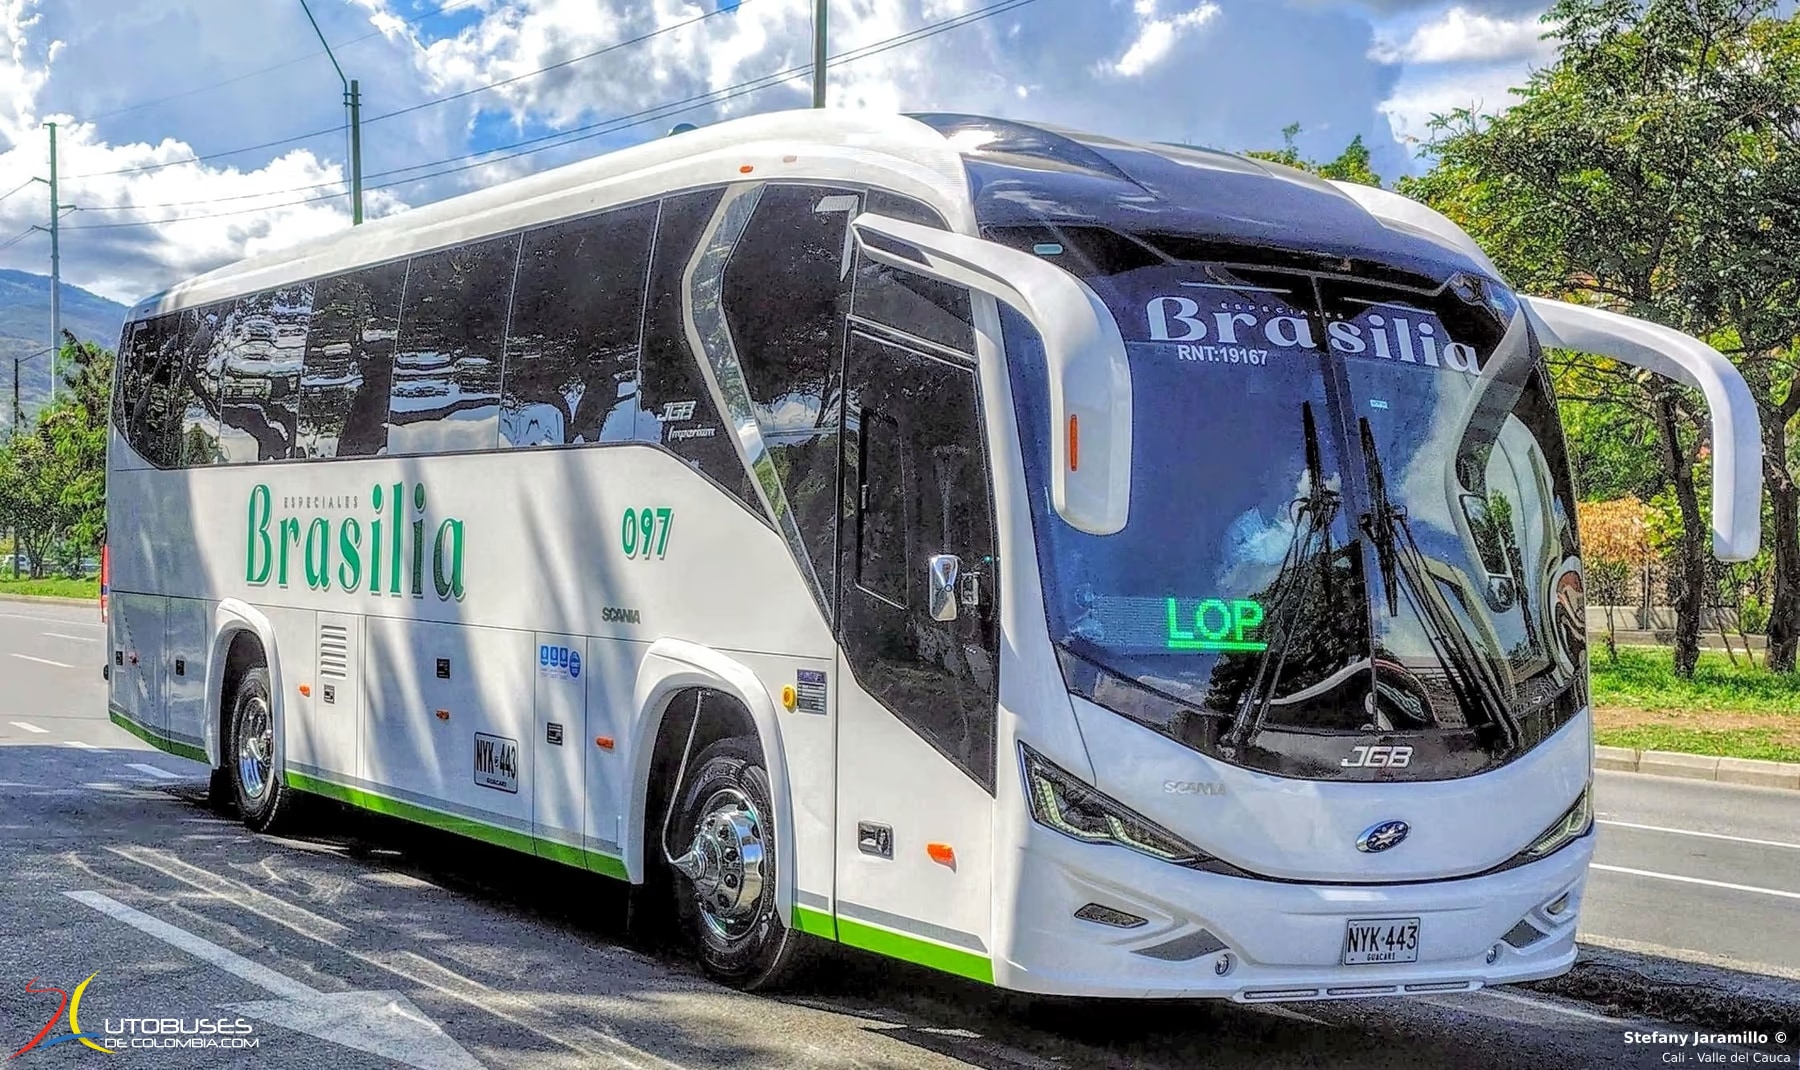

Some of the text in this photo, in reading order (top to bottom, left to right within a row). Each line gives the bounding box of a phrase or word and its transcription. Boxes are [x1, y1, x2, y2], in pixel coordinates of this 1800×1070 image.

[1146, 296, 1483, 376] Brasilia
[1177, 344, 1268, 366] RNT:19167
[656, 400, 697, 422] JGB
[283, 495, 359, 509] ESPECIALES
[246, 481, 466, 602] Brasilia
[621, 506, 674, 561] 097
[601, 606, 641, 625] SCANIA
[1167, 597, 1265, 641] LOP
[1340, 745, 1414, 768] JGB
[1163, 780, 1227, 797] SCANIA
